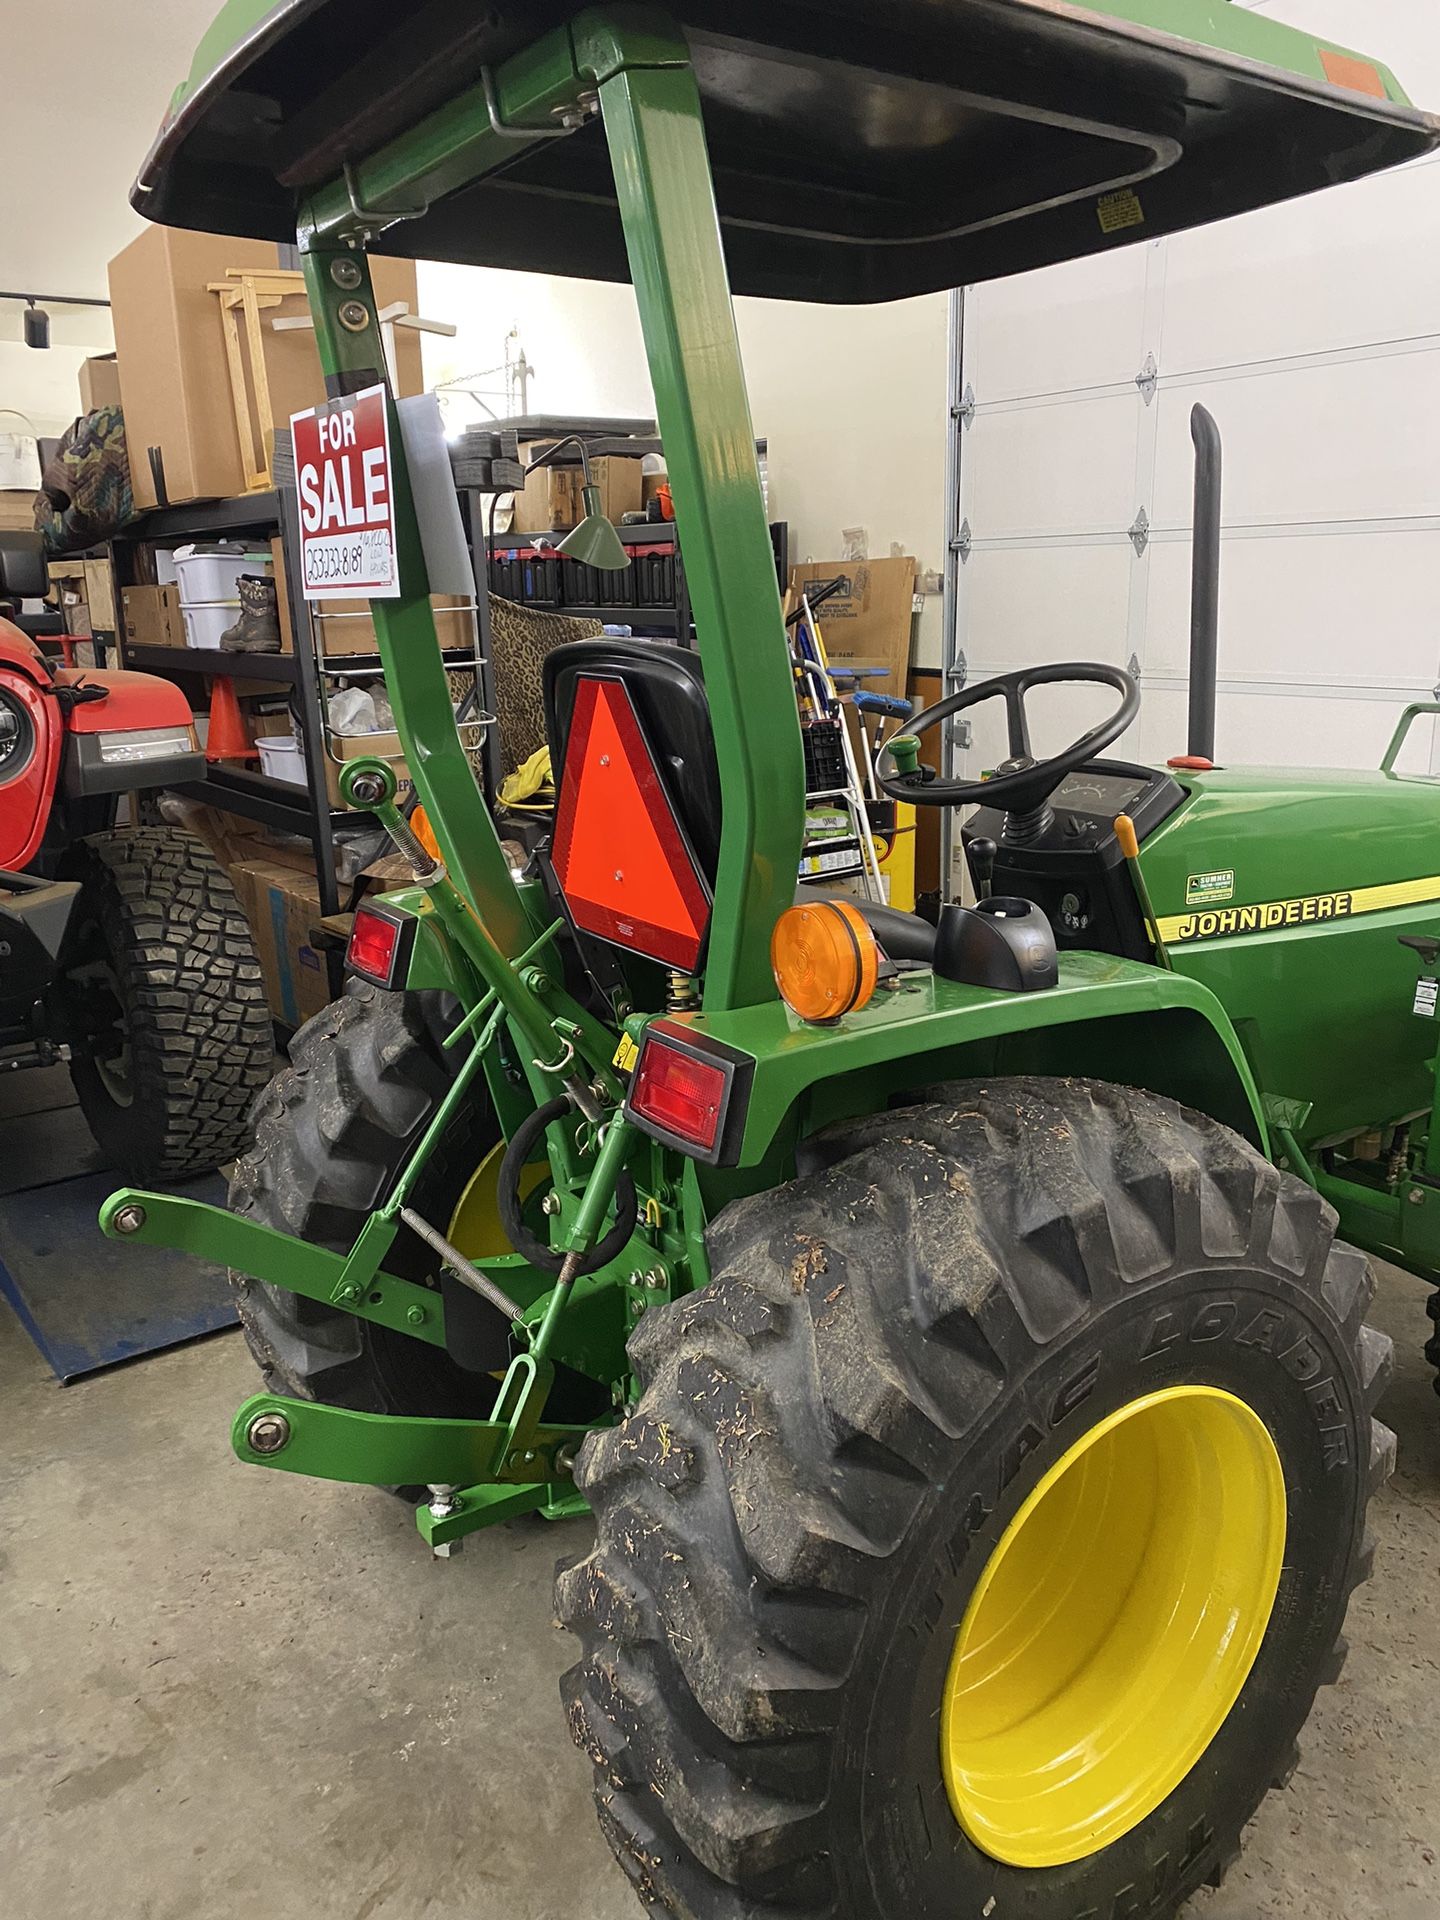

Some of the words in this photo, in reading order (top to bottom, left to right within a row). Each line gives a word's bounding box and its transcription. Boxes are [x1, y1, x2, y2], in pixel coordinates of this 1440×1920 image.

[318, 410, 356, 453] FOR
[300, 446, 389, 532] SALE
[1179, 907, 1259, 938] JOHN
[1265, 893, 1351, 925] DEERE
[1139, 1301, 1351, 1471] LOADER
